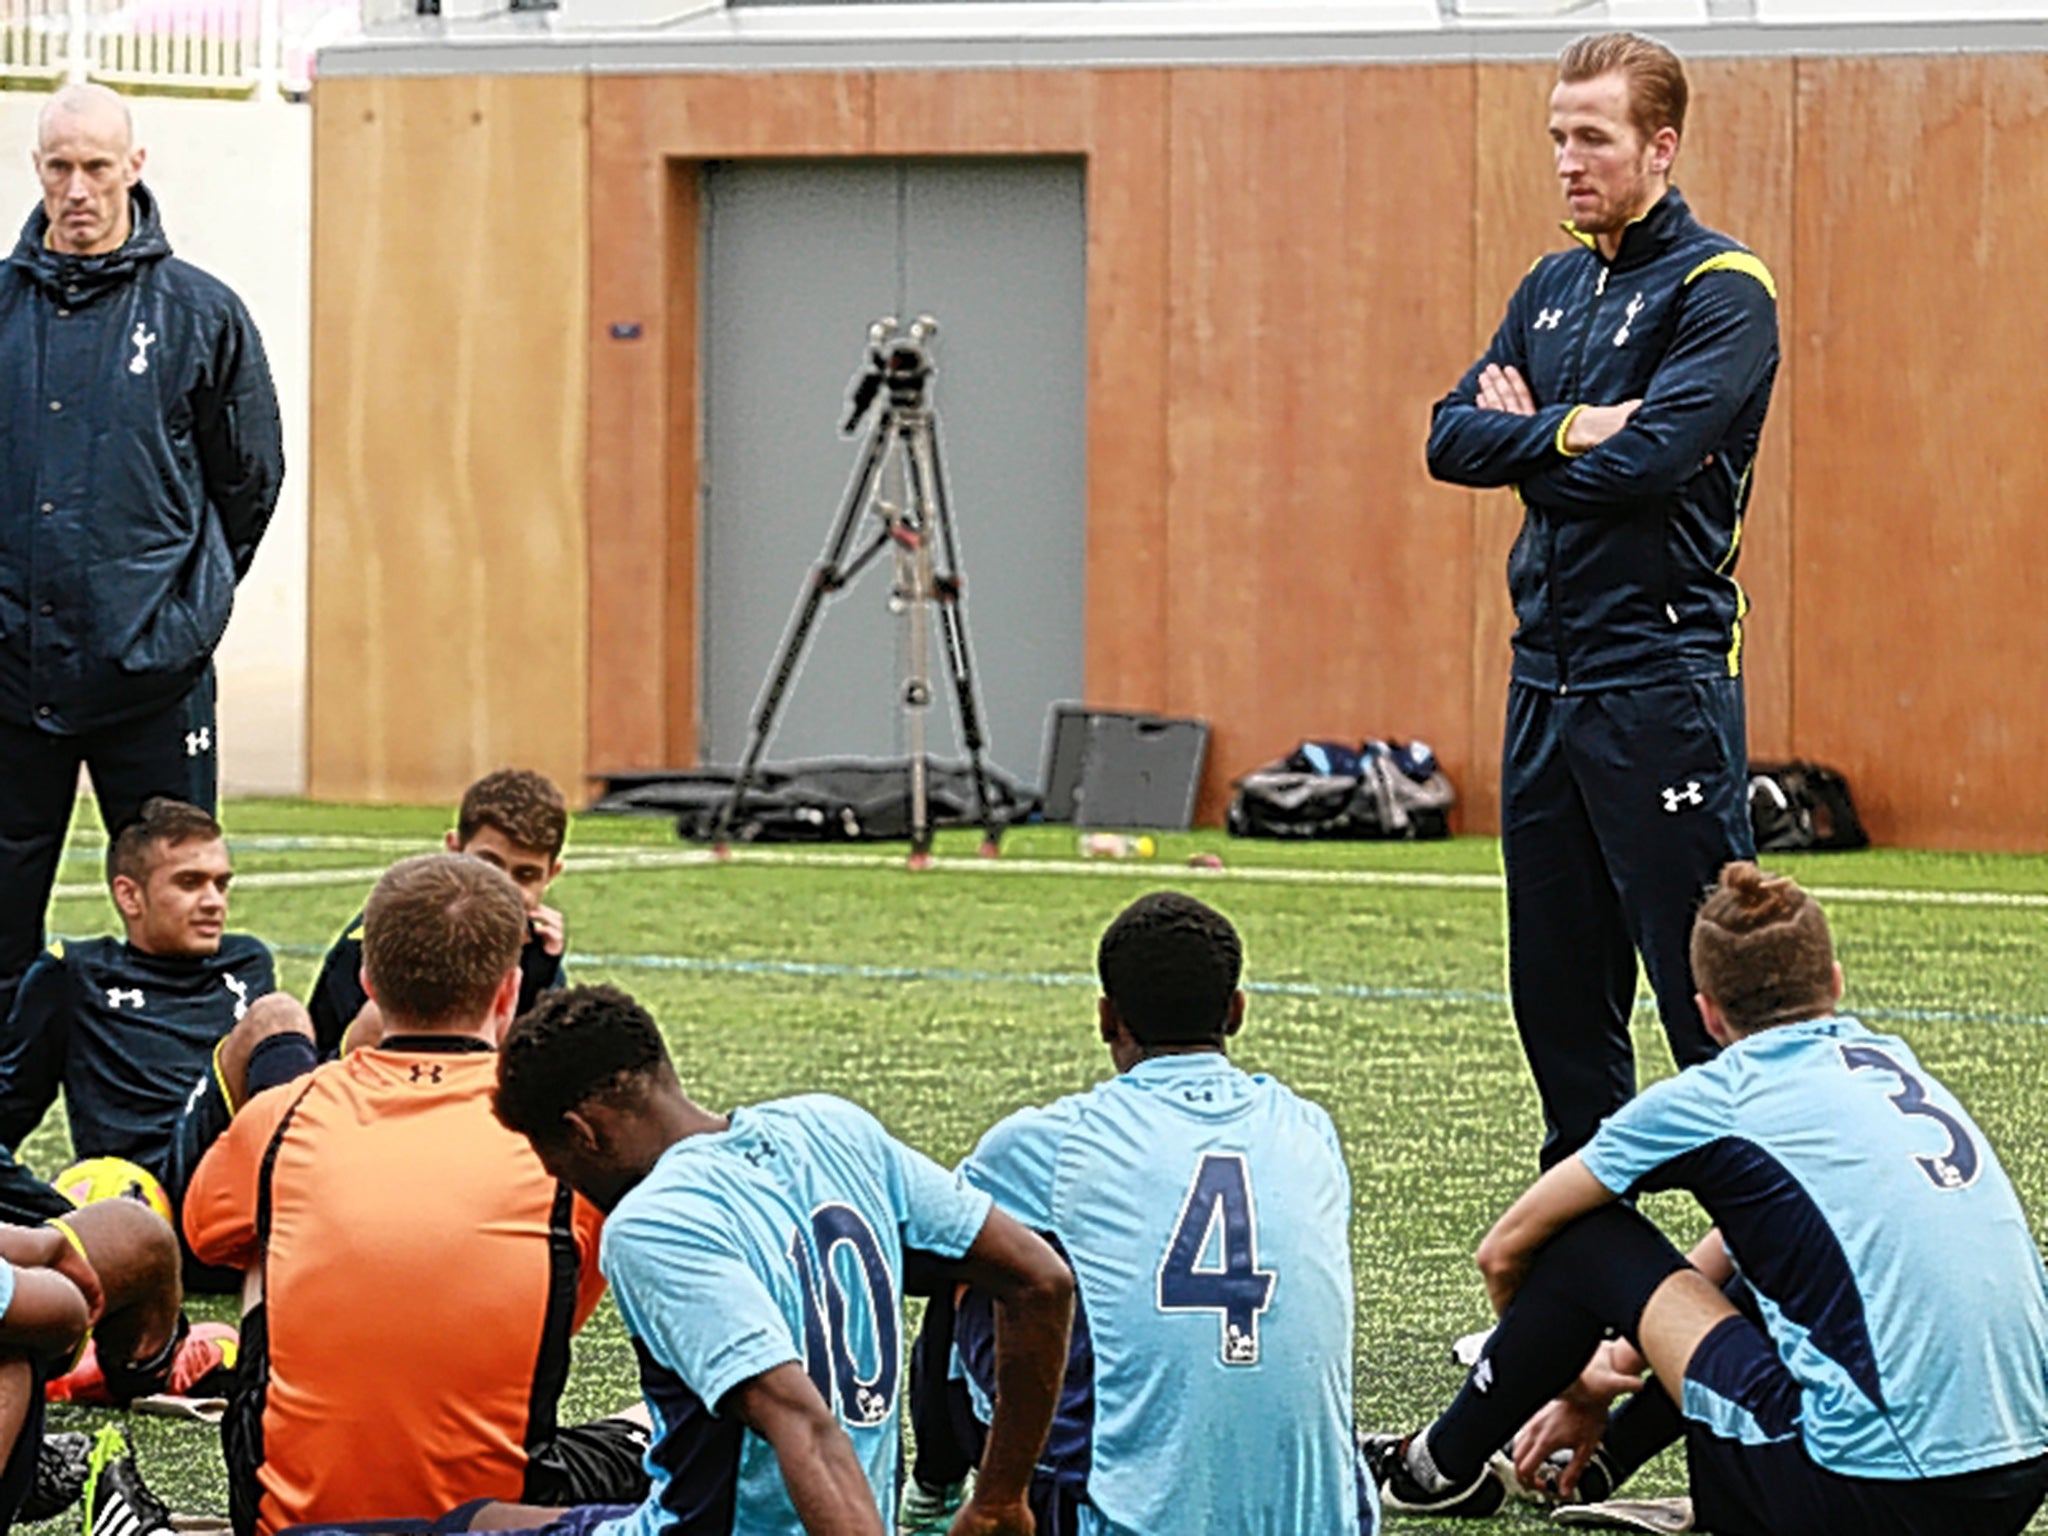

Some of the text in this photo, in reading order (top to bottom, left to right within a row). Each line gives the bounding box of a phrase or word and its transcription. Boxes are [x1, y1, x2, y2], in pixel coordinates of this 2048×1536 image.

[1838, 1043, 1982, 1189] 3
[787, 1202, 901, 1427] 10
[1156, 1152, 1277, 1366] 4
